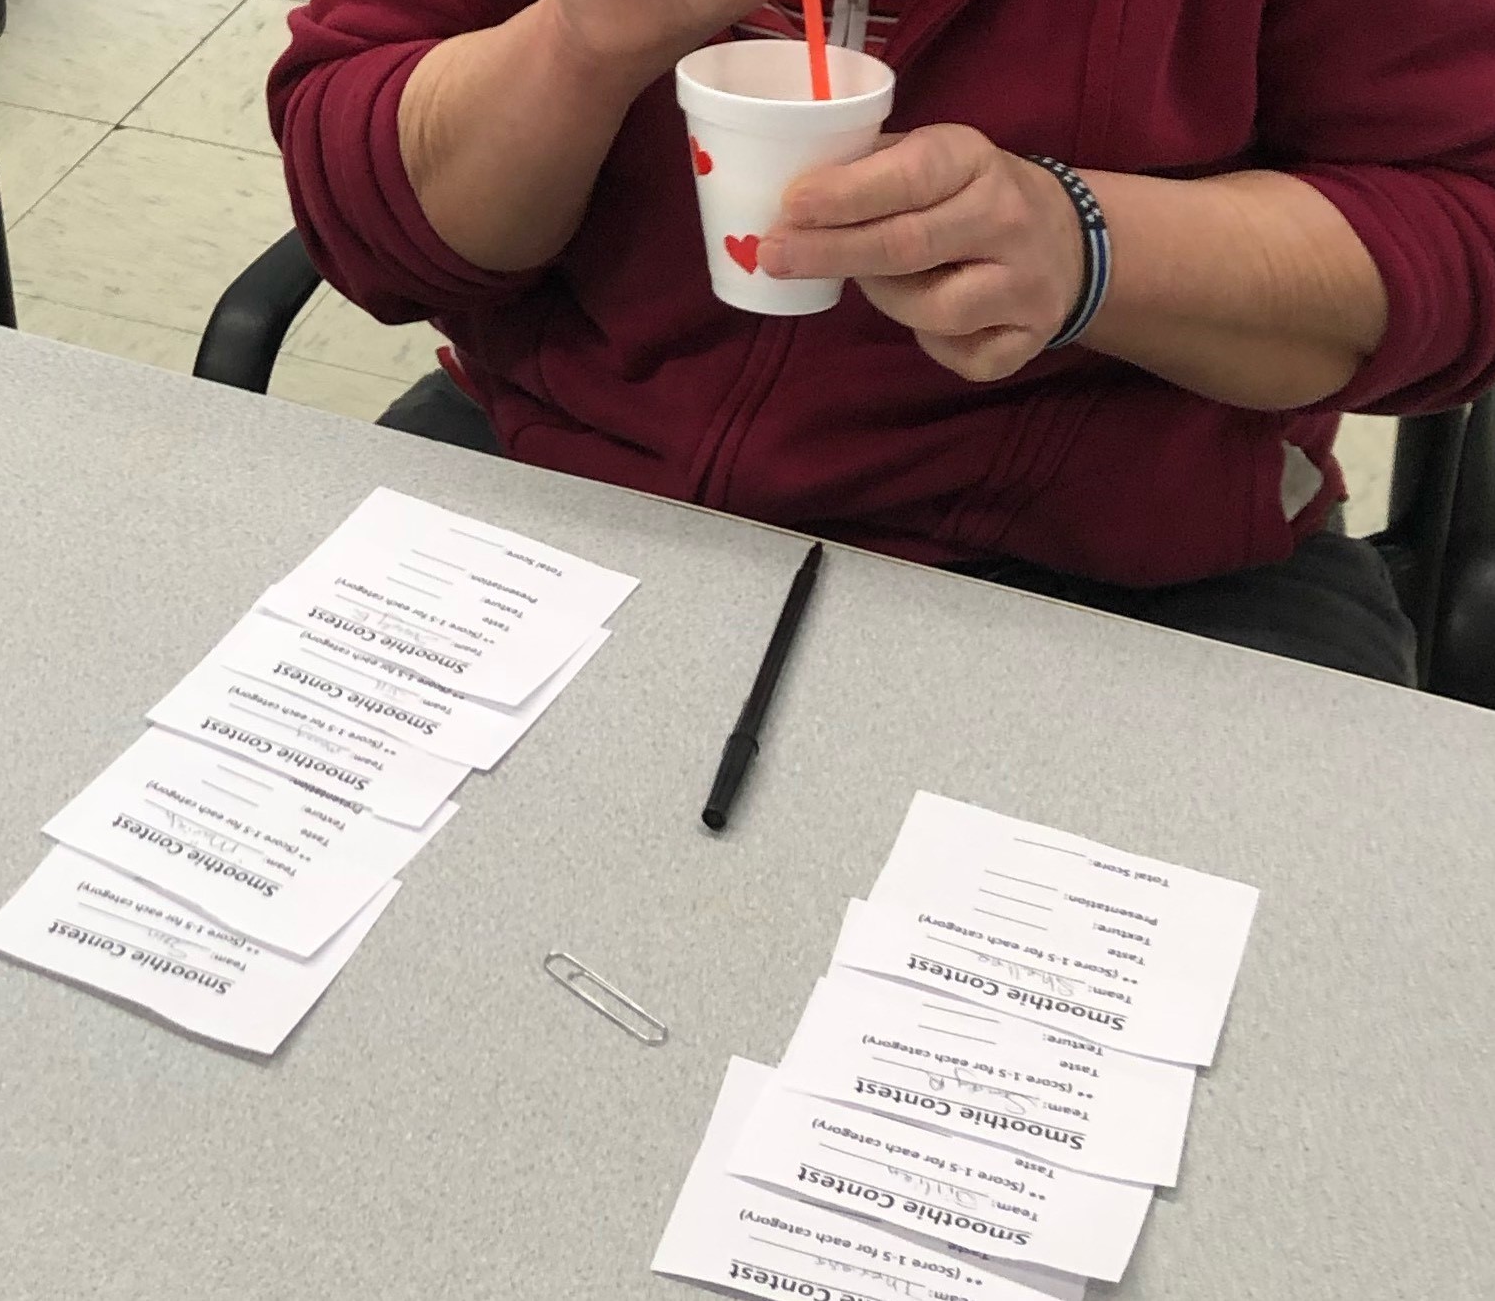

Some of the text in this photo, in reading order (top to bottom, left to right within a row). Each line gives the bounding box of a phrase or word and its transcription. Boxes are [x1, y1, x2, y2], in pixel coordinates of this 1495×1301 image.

[308, 608, 468, 674] Smoothie Contest
[274, 662, 438, 736] Smoothie Contest
[200, 718, 370, 790] Smoothie Contest
[112, 816, 278, 898] Smoothie Contest
[1090, 860, 1170, 888] Total Score:
[1064, 894, 1158, 926] Presentation:
[48, 920, 232, 994] Smoothie Contest
[918, 914, 1118, 978] (Score 1-5 for each category)
[1094, 924, 1150, 946] Texture:
[1108, 948, 1146, 966] Taste
[906, 956, 1126, 1030] Smoothie Contest
[1088, 986, 1132, 1004] Team:
[862, 1034, 1072, 1094] (Score 1-5 for each category)
[1042, 1034, 1104, 1056] Texture:
[1060, 1060, 1098, 1078] Taste
[854, 1076, 1084, 1150] Smoothie Contest
[1044, 1102, 1090, 1122] Team:
[812, 1118, 1026, 1194] (Score 1-5 for each category)
[1014, 1158, 1054, 1180] Taste
[798, 1166, 1030, 1246] Smoothie Contest
[992, 1200, 1038, 1222] Team:
[740, 1208, 962, 1280] (Score 1-5 for each category)
[728, 1262, 830, 1301] Contest
[928, 1290, 968, 1301] eam:
